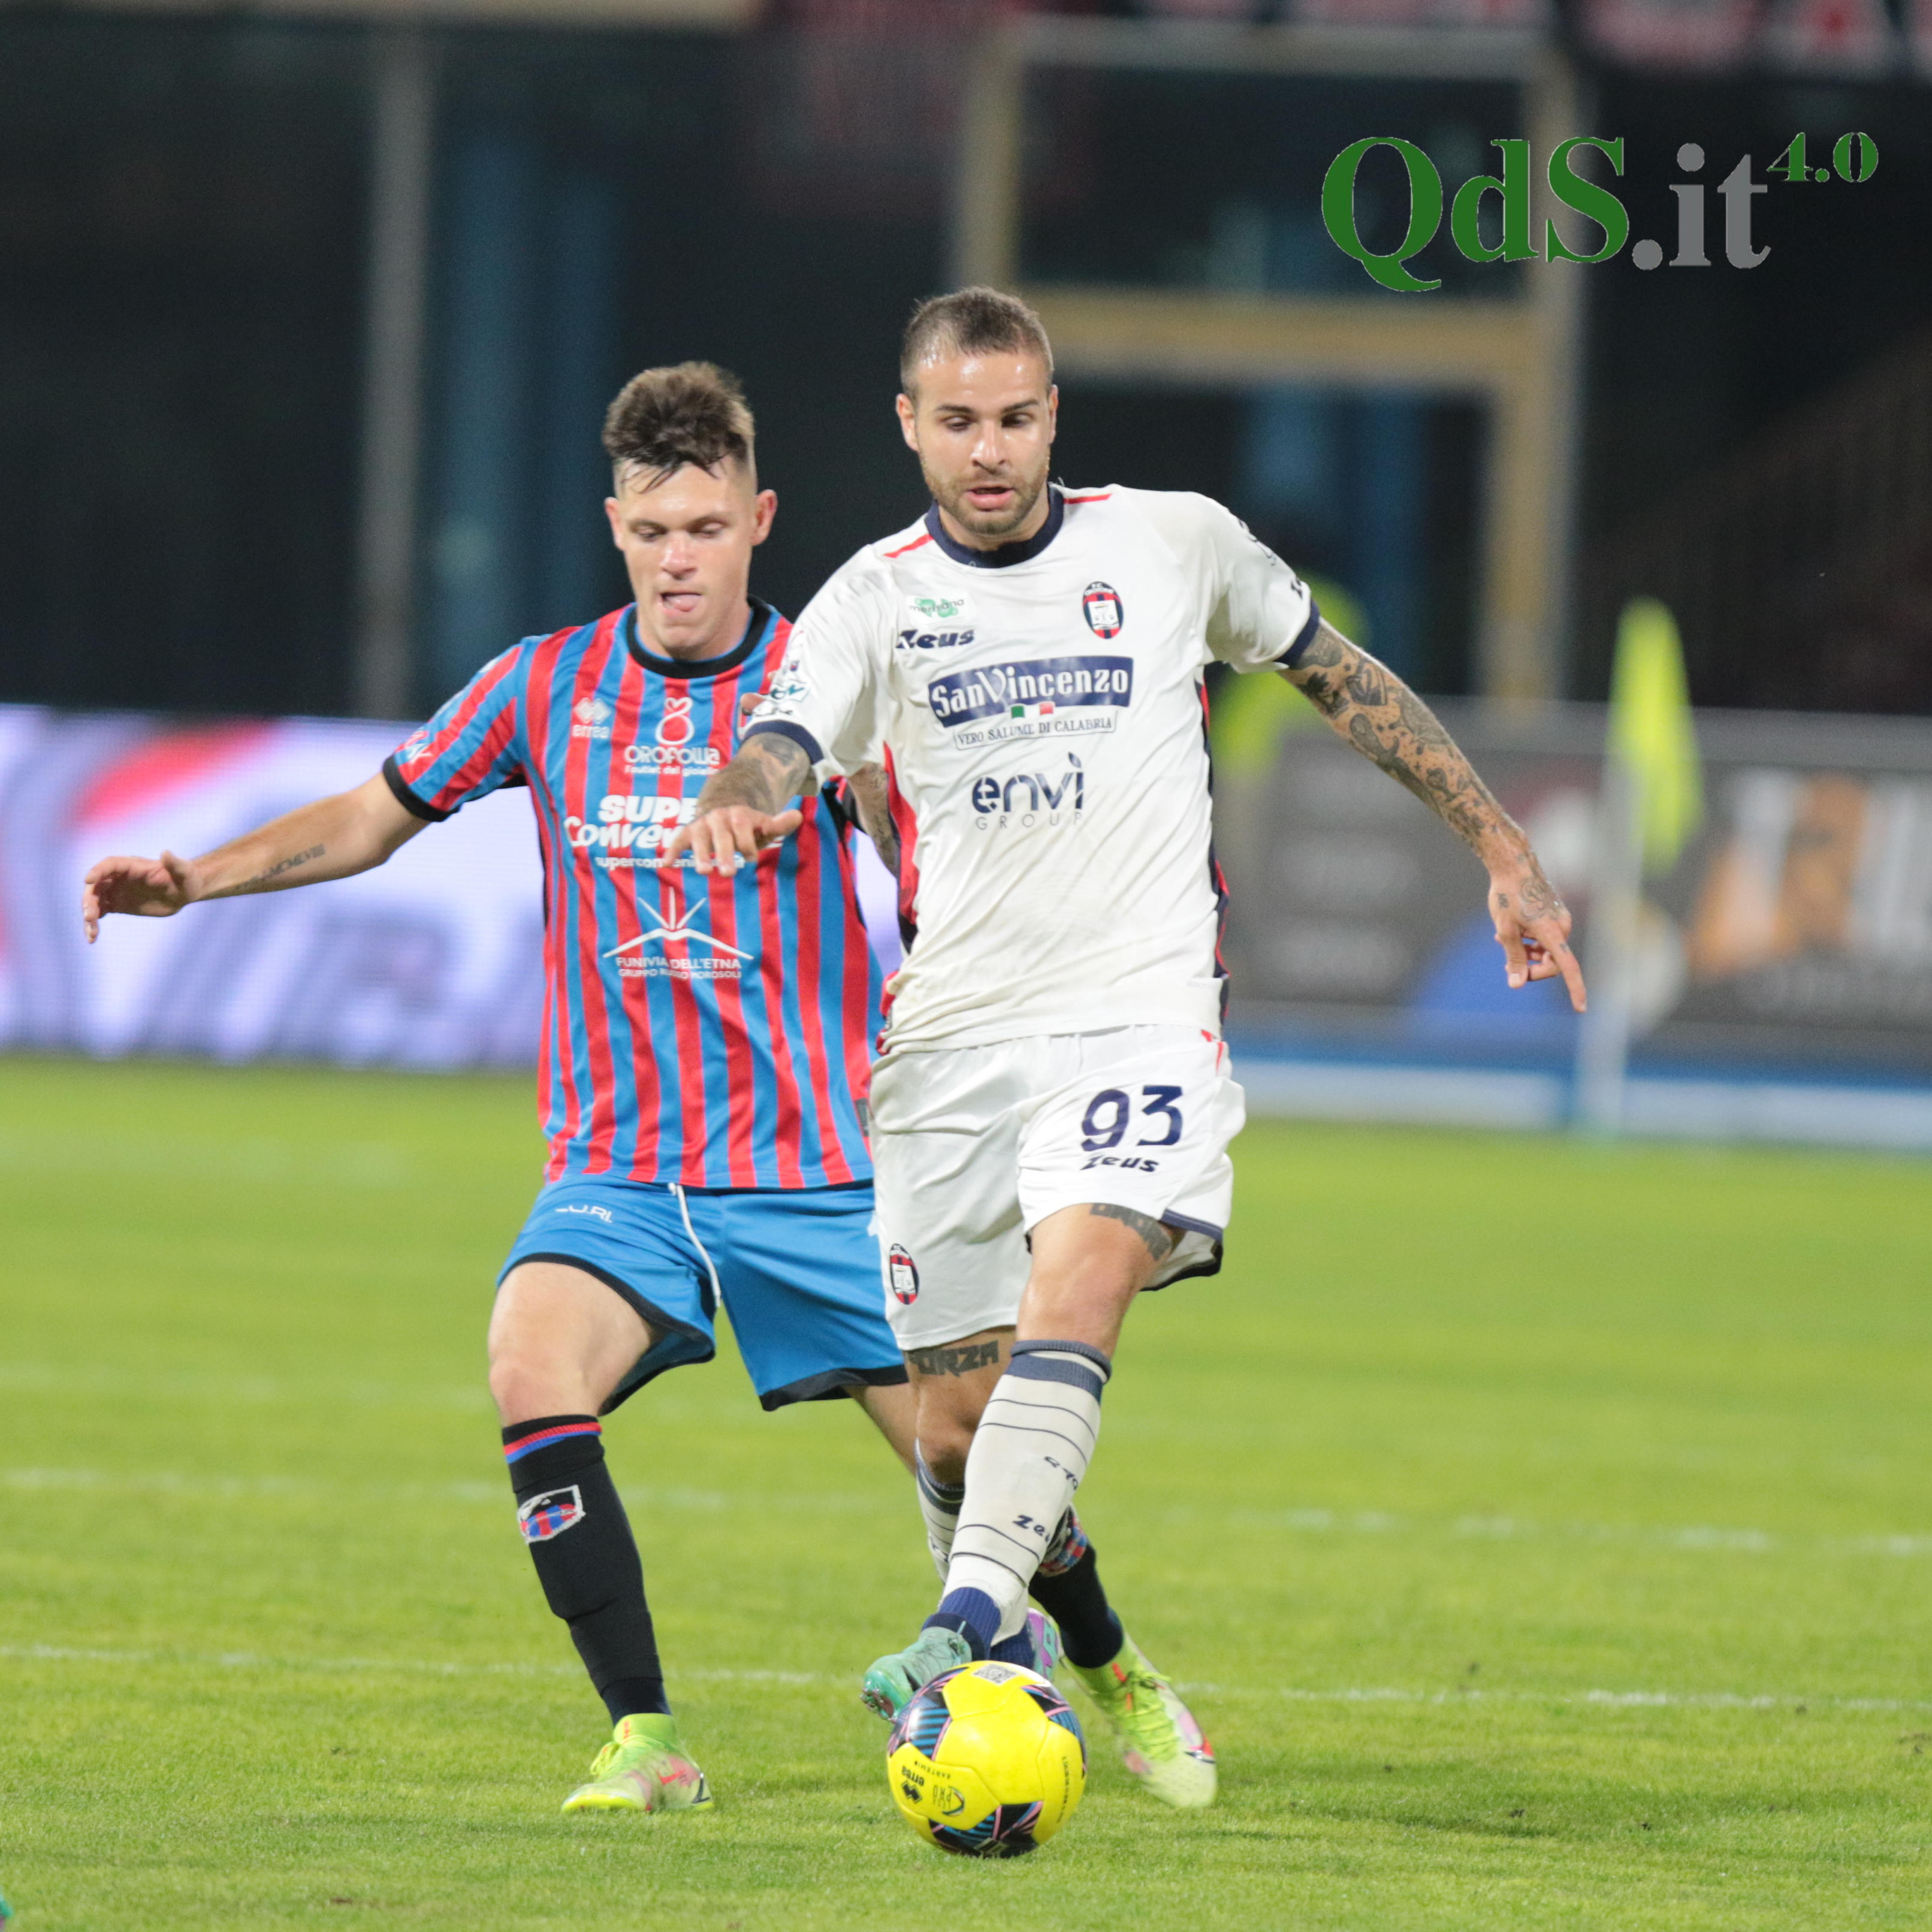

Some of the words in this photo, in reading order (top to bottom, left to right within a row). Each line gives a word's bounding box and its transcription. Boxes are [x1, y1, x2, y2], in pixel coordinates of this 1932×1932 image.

[896, 629, 974, 649] Zeus
[958, 731, 984, 745] VERO
[988, 723, 1036, 740] SALUME
[1039, 722, 1050, 733] DI
[1054, 717, 1112, 732] CALABRIA
[599, 794, 698, 823] SUPE
[976, 811, 1082, 831] GROUP
[615, 956, 669, 967] FUNIVIA
[1080, 1084, 1183, 1152] 93
